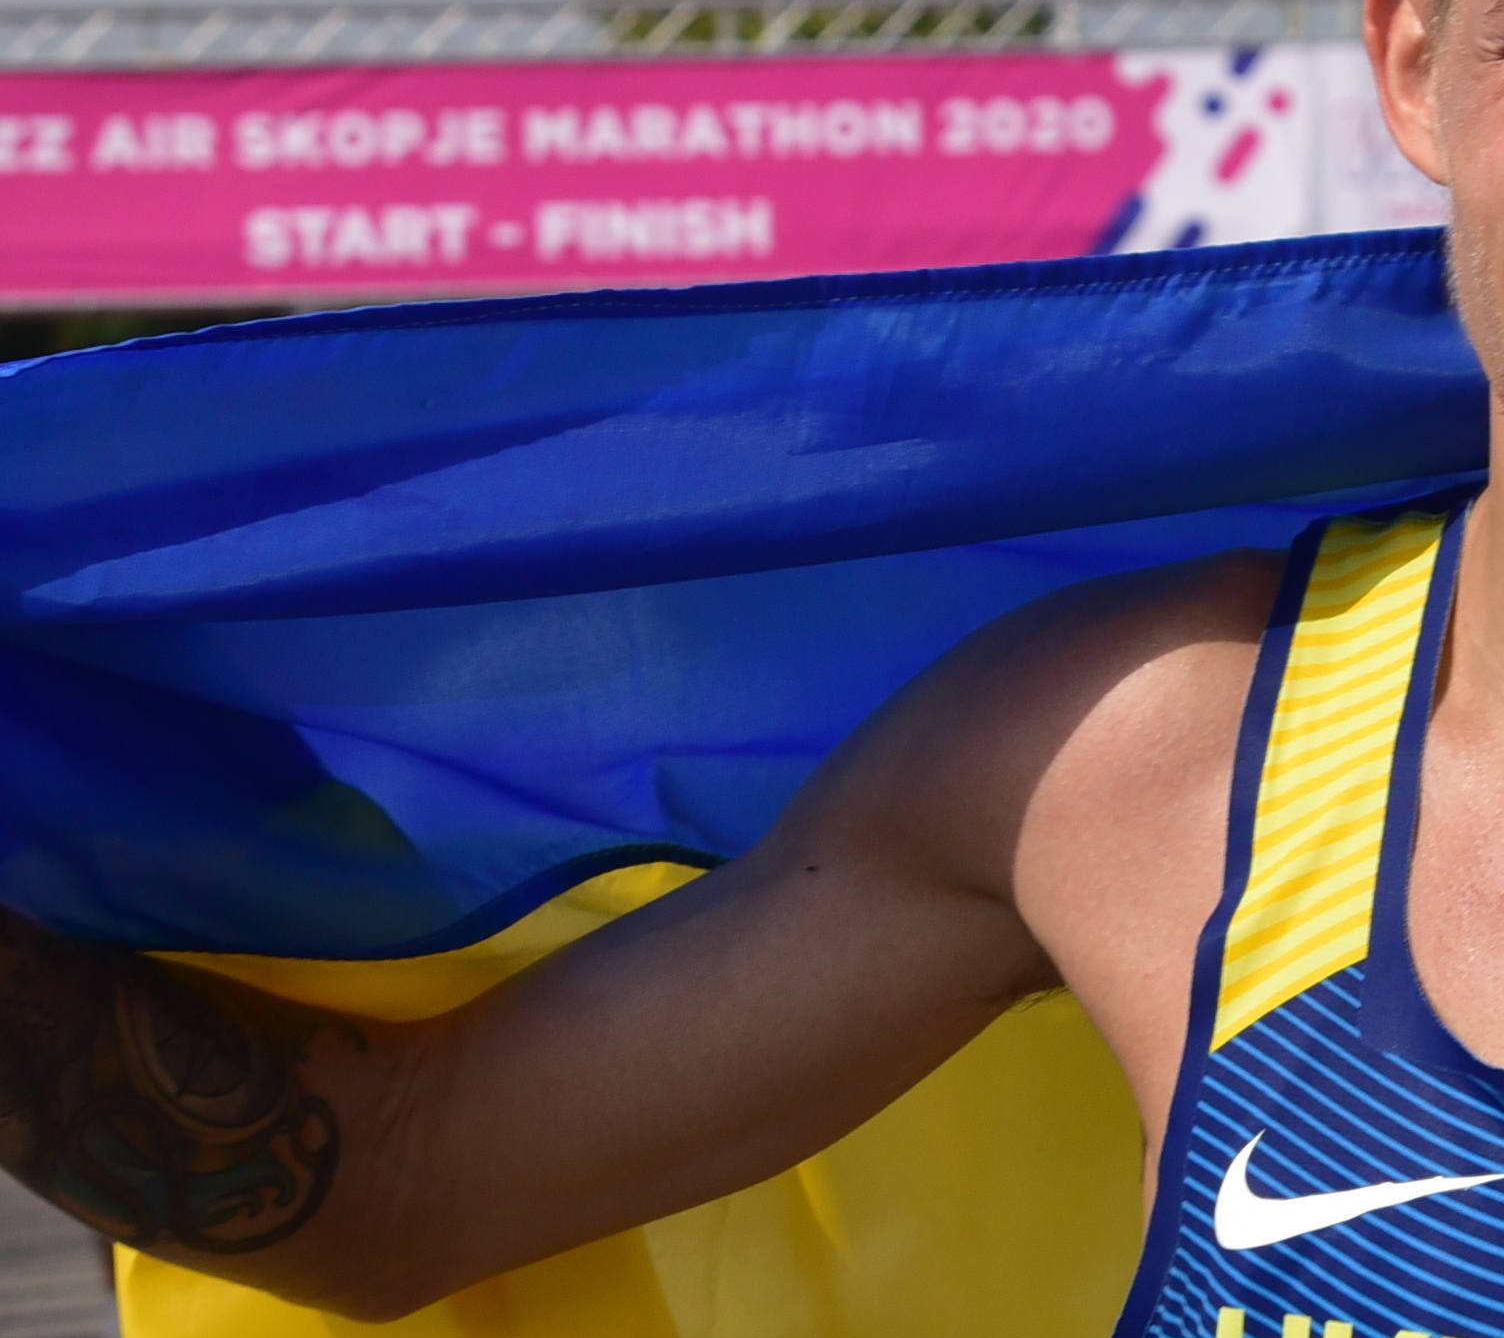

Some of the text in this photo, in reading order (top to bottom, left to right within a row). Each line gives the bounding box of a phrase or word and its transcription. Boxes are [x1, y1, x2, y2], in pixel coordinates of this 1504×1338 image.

[93, 114, 216, 171] AIR
[235, 108, 506, 170] SKOPJE
[522, 100, 921, 161] MARATHON
[940, 95, 1115, 155] 2020
[245, 204, 477, 268] START
[537, 199, 773, 258] FINISH
